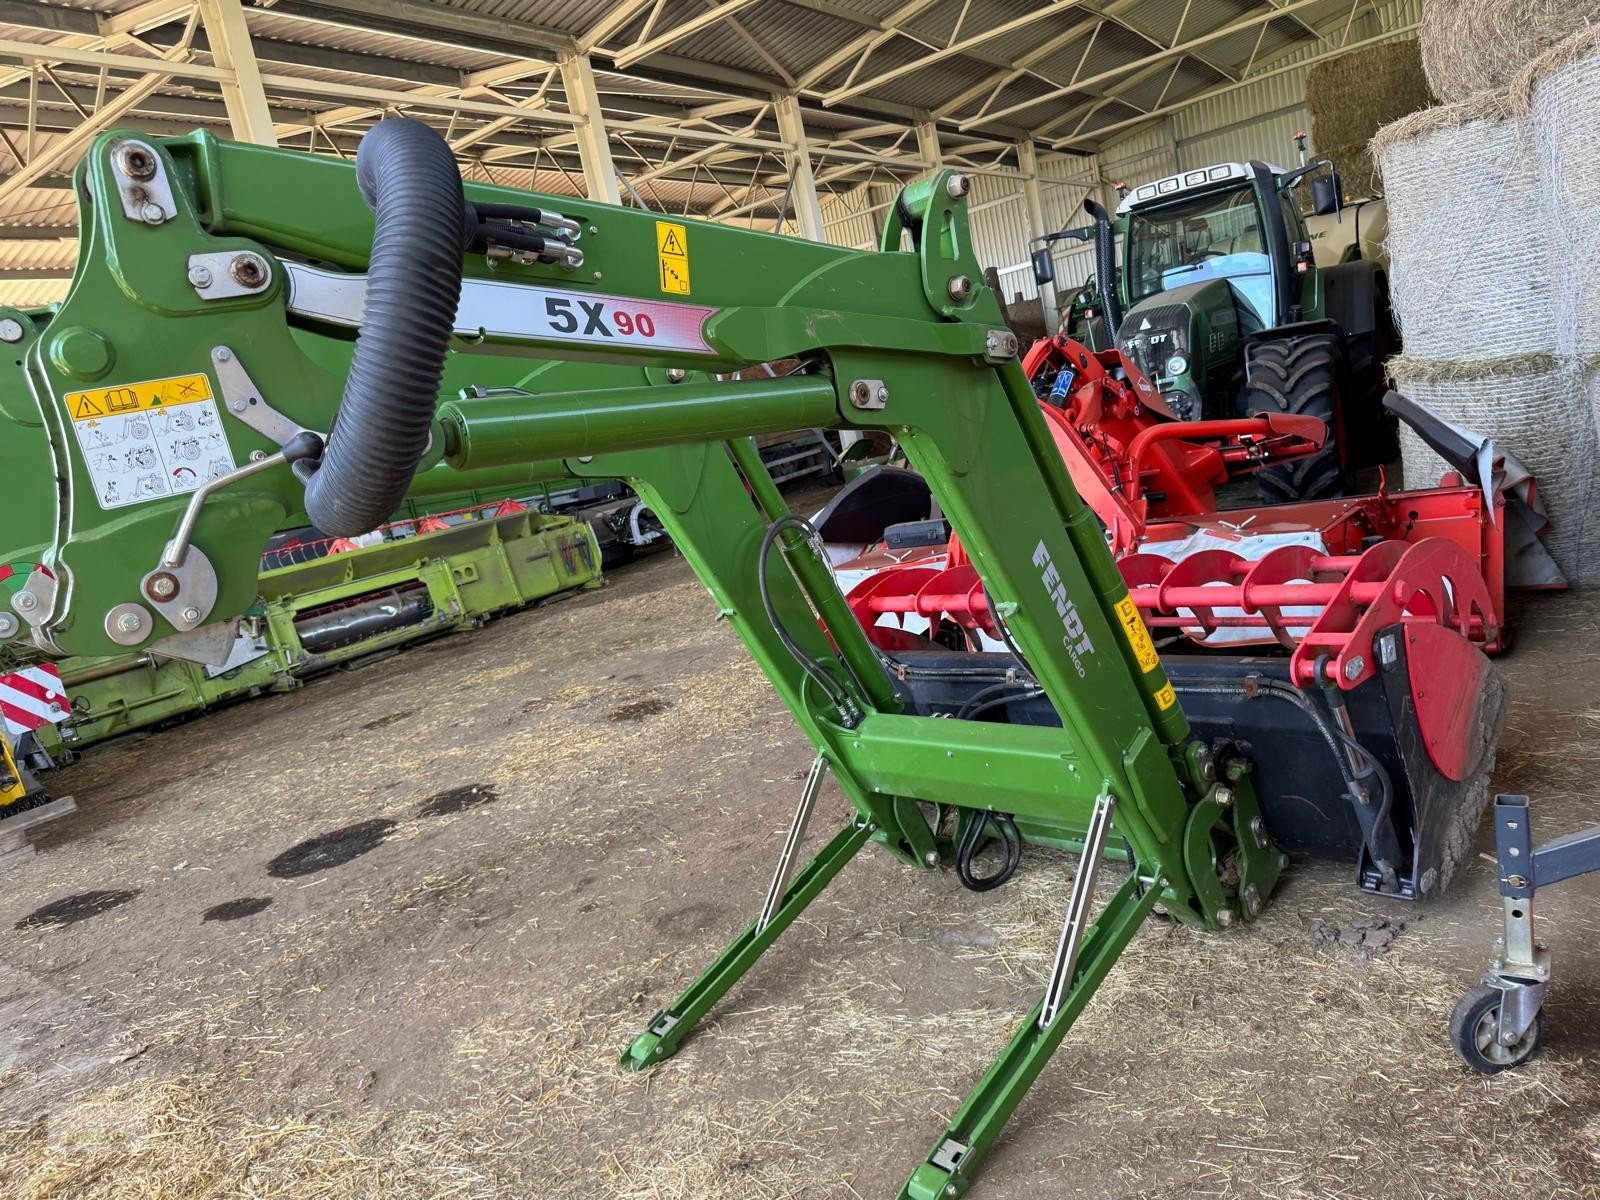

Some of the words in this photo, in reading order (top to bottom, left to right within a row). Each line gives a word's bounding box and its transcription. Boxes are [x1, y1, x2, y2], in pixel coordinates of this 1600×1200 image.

[1127, 334, 1167, 349] FEDT
[1032, 540, 1095, 656] FENDT
[1063, 636, 1086, 679] CARGO
